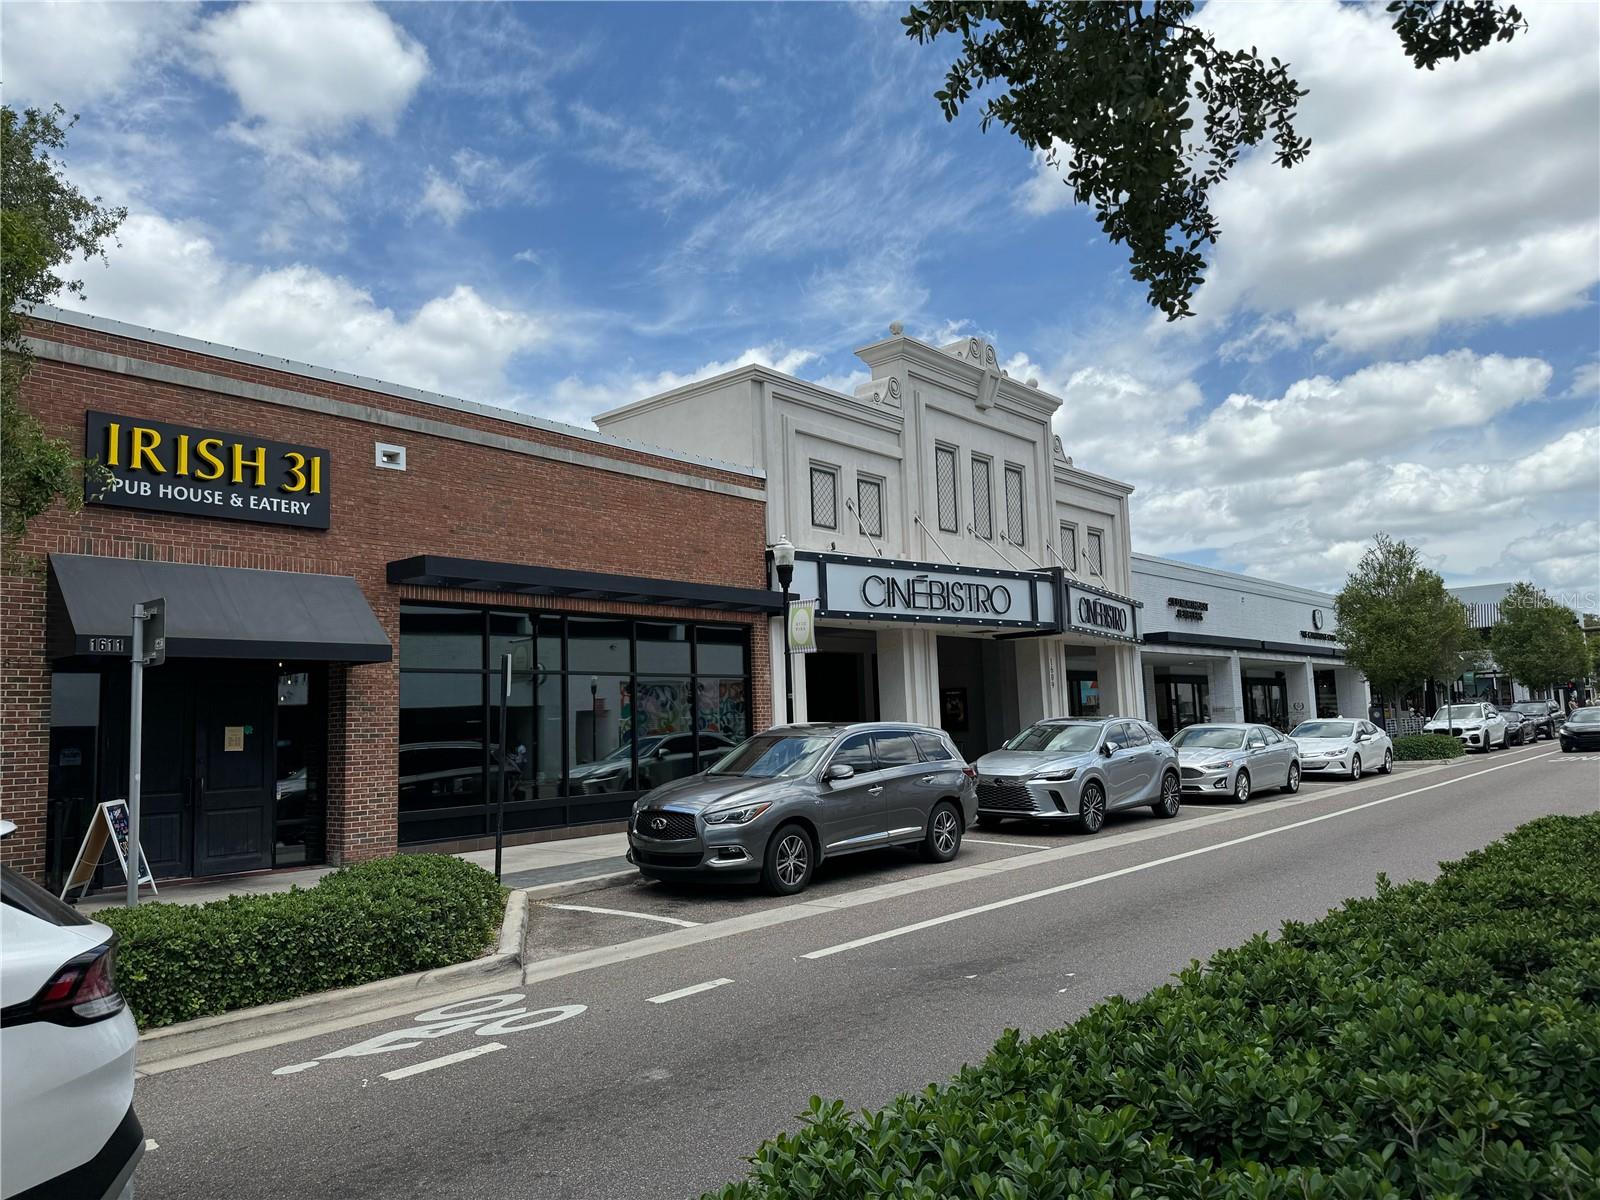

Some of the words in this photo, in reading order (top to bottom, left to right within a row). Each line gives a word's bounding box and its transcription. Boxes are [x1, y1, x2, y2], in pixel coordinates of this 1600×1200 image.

[107, 423, 267, 486] IRISH
[281, 452, 321, 494] 31
[112, 478, 152, 496] PUB
[159, 484, 224, 505] HOUSE
[230, 493, 244, 508] &
[250, 495, 311, 516] EATERY
[861, 574, 1012, 615] CINÉBISTRO
[90, 638, 124, 652] 1611
